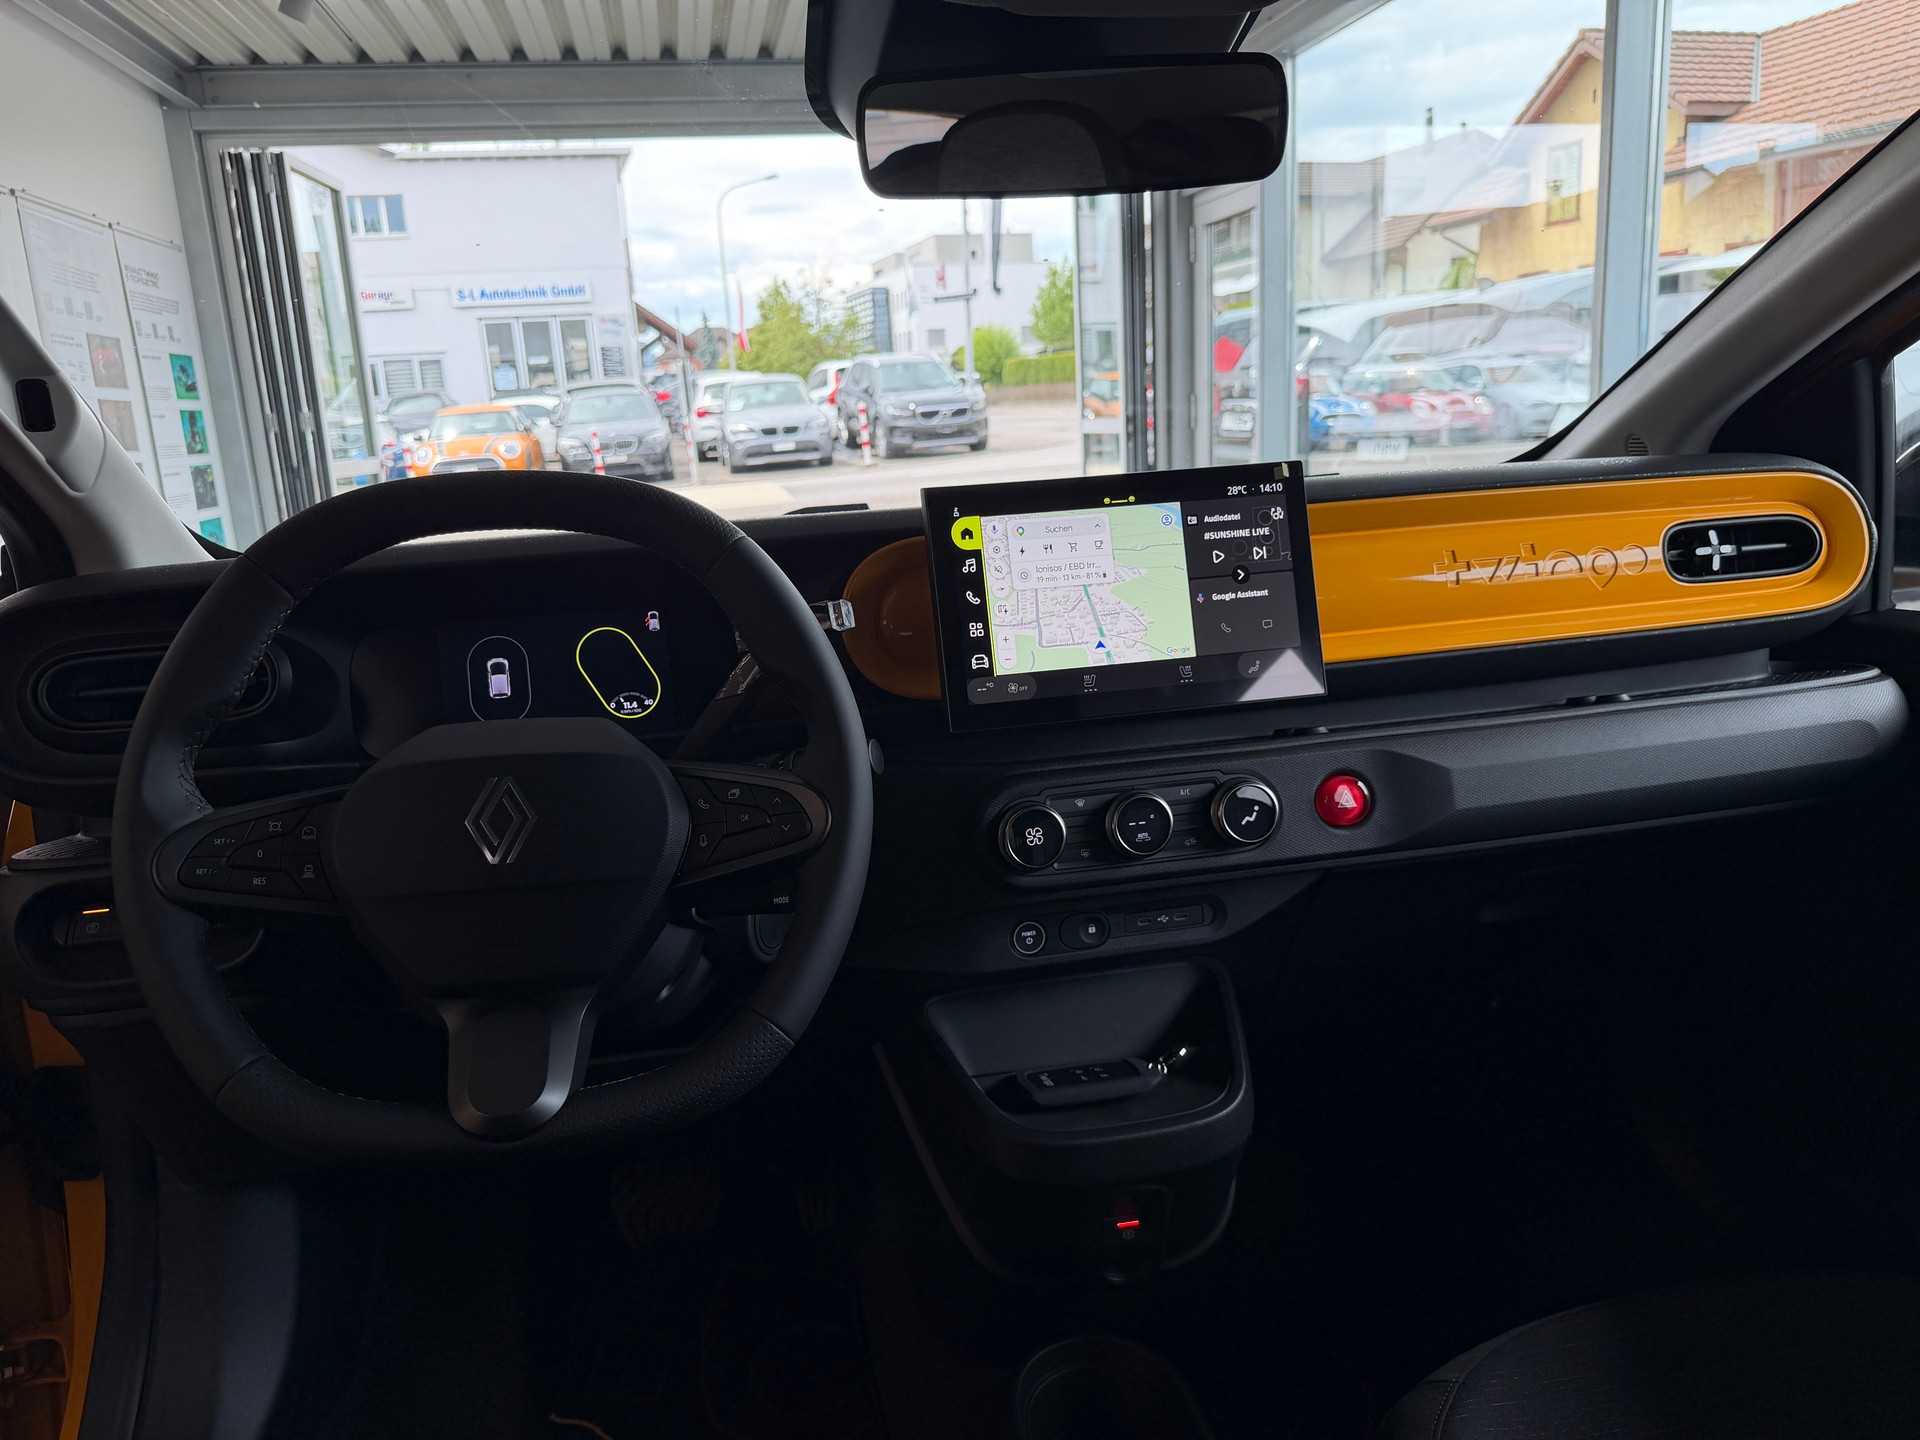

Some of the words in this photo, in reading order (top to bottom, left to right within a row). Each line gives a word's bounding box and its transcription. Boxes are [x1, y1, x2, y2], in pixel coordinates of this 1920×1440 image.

[479, 284, 548, 301] Autotechnik
[551, 283, 586, 298] GmbH
[1227, 485, 1248, 496] 28°C
[1259, 482, 1283, 493] 14:10
[1204, 512, 1241, 523] Audiodatei
[1045, 524, 1073, 534] Suchen
[1204, 530, 1251, 541] #SUNSHINE
[1252, 526, 1270, 536] LIVE
[1036, 564, 1063, 574] Ionisos
[1068, 562, 1086, 571] EBD
[1433, 542, 1649, 591] twingo
[1046, 574, 1058, 582] min
[1063, 573, 1070, 581] 13
[1071, 572, 1081, 580] km
[1086, 571, 1094, 579] 81
[1212, 591, 1236, 602] Google
[1237, 589, 1269, 599] Assistant
[1166, 645, 1191, 655] Google
[622, 701, 639, 710] 11.4
[1180, 788, 1191, 796] A/C
[213, 838, 226, 846] SET
[195, 868, 209, 876] SET
[252, 877, 267, 886] RES
[773, 895, 790, 905] MODE
[1021, 930, 1037, 938] POWER
